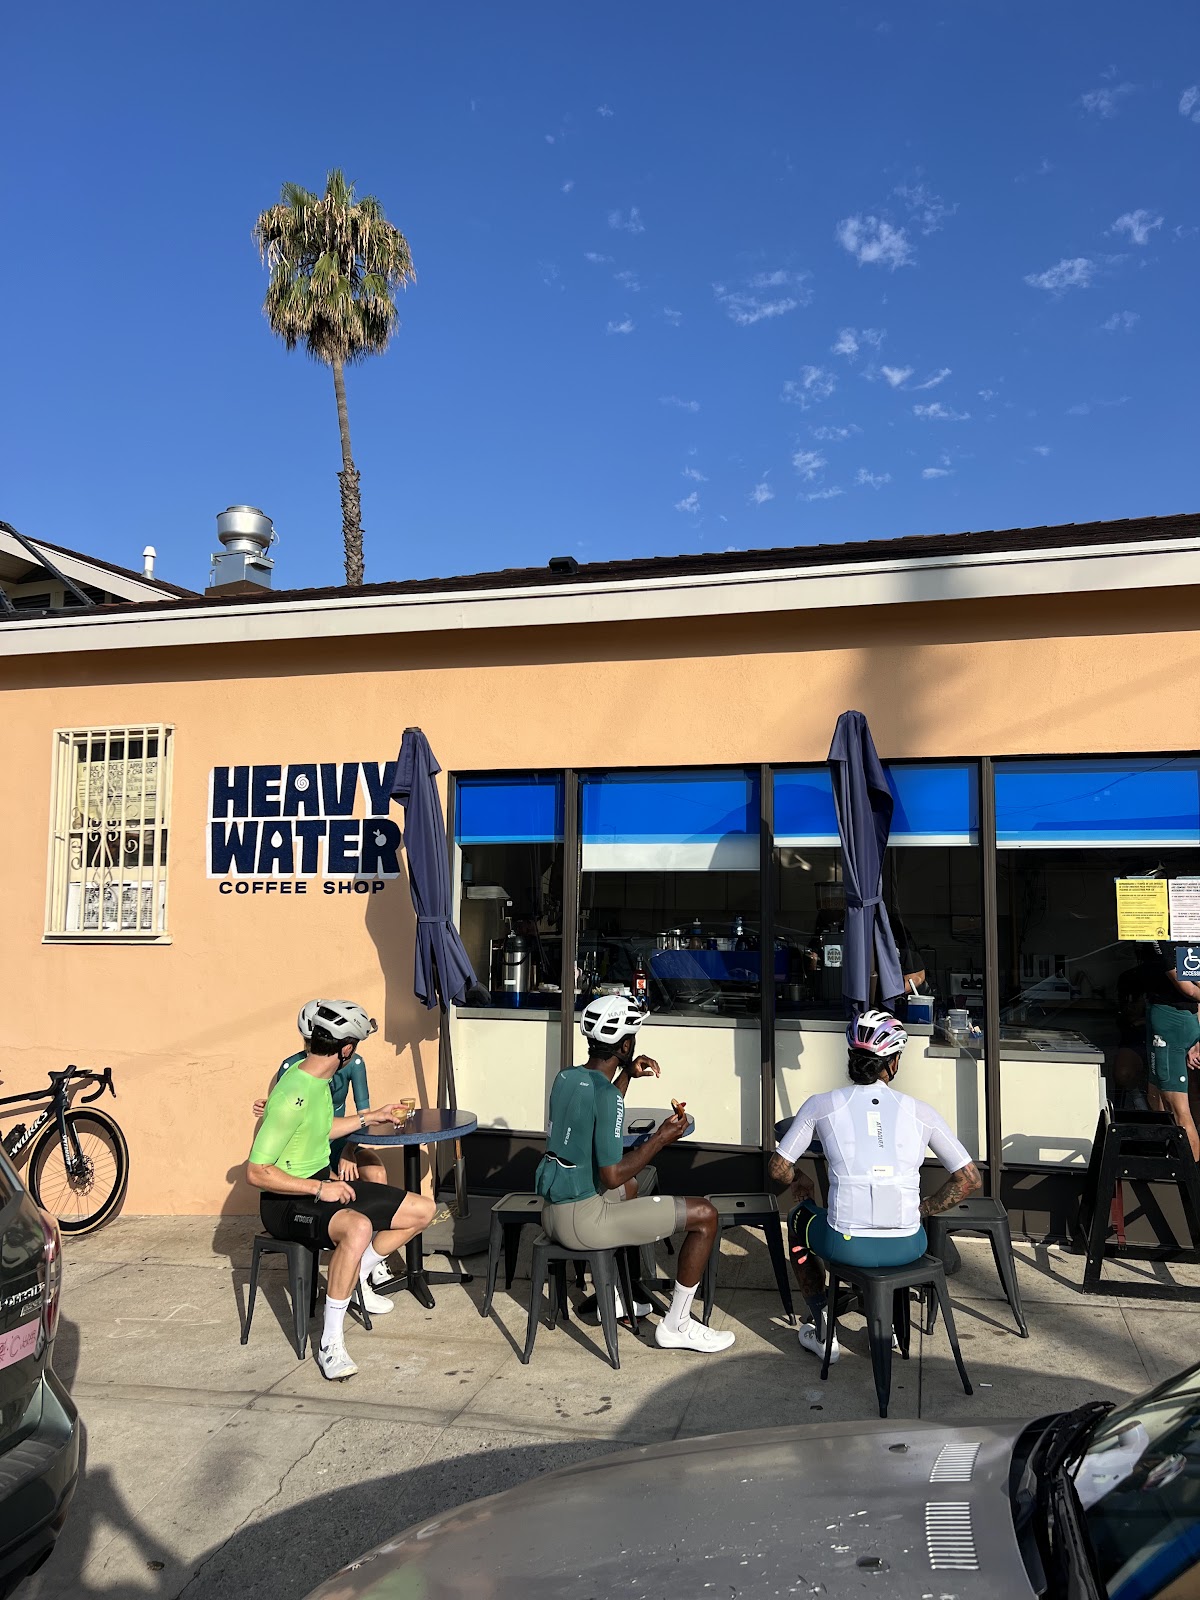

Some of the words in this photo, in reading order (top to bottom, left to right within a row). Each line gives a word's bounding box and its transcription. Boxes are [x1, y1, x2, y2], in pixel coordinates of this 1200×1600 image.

[213, 761, 398, 818] HEAVY
[211, 818, 401, 874] WATER
[218, 881, 308, 894] COFFEE
[323, 880, 385, 894] SHOP
